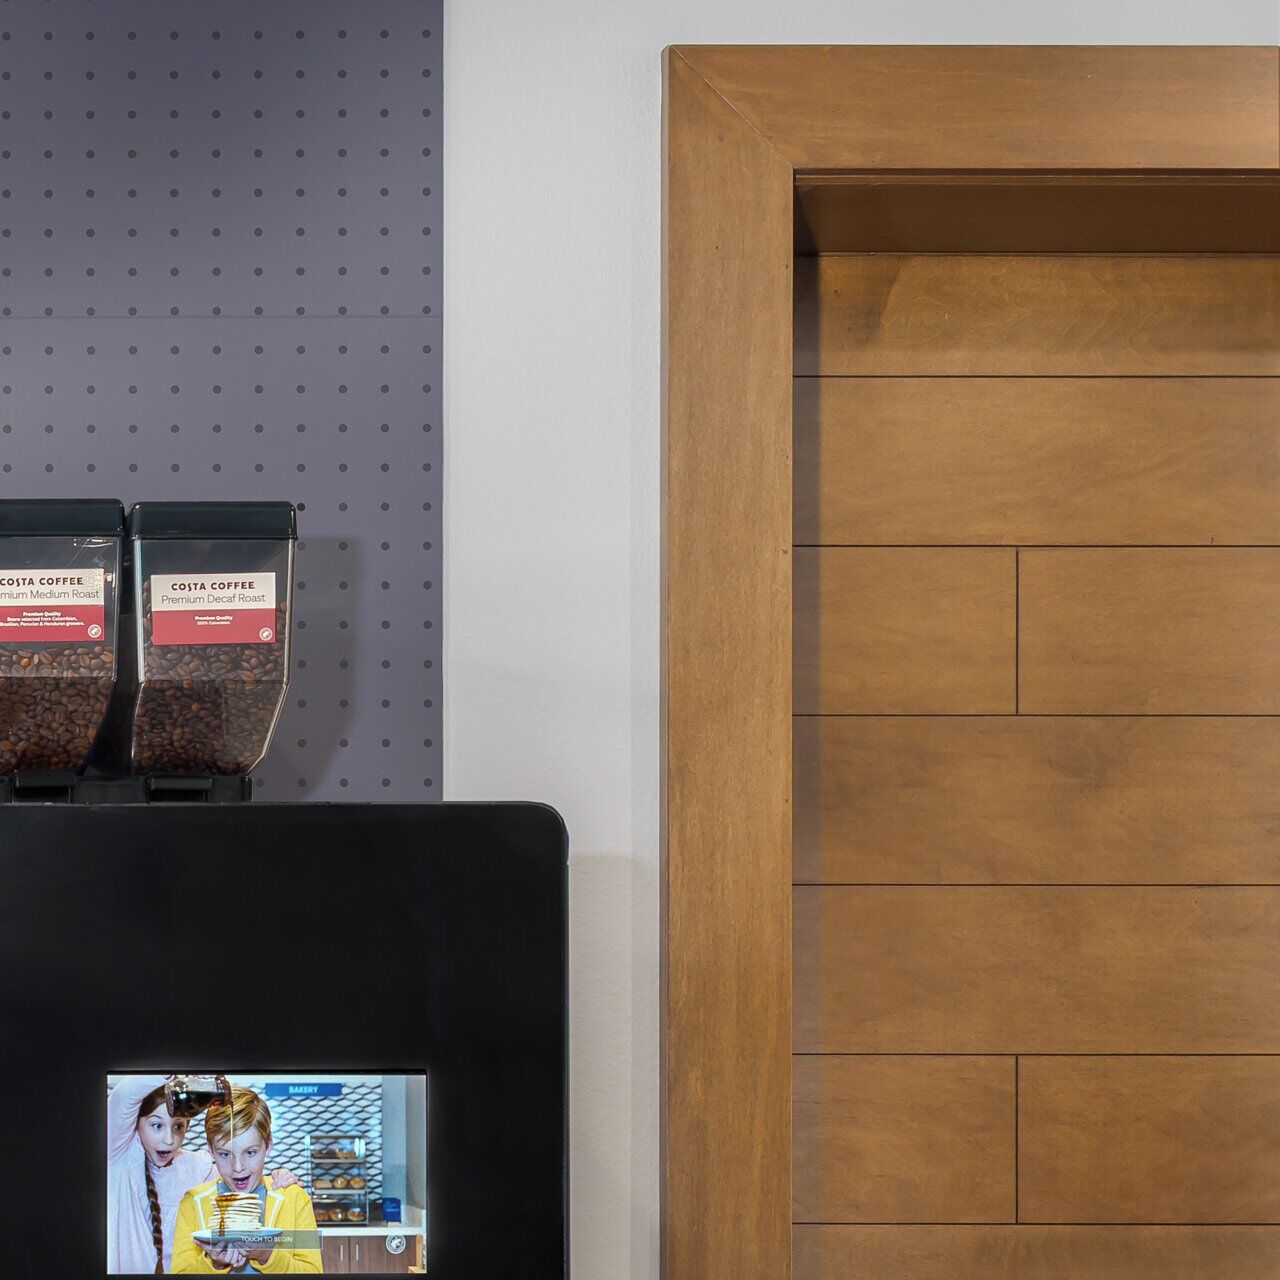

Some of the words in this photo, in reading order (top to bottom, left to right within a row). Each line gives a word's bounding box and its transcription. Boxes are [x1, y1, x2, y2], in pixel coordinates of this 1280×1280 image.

[0, 578, 35, 587] COSTA
[39, 577, 84, 585] COFFEE
[171, 583, 206, 592] COSTA
[210, 582, 255, 590] COFFEE
[30, 590, 70, 599] Medium
[72, 589, 100, 598] Roast
[161, 594, 205, 604] Premium
[207, 594, 236, 604] Decaf
[238, 593, 266, 603] Roast
